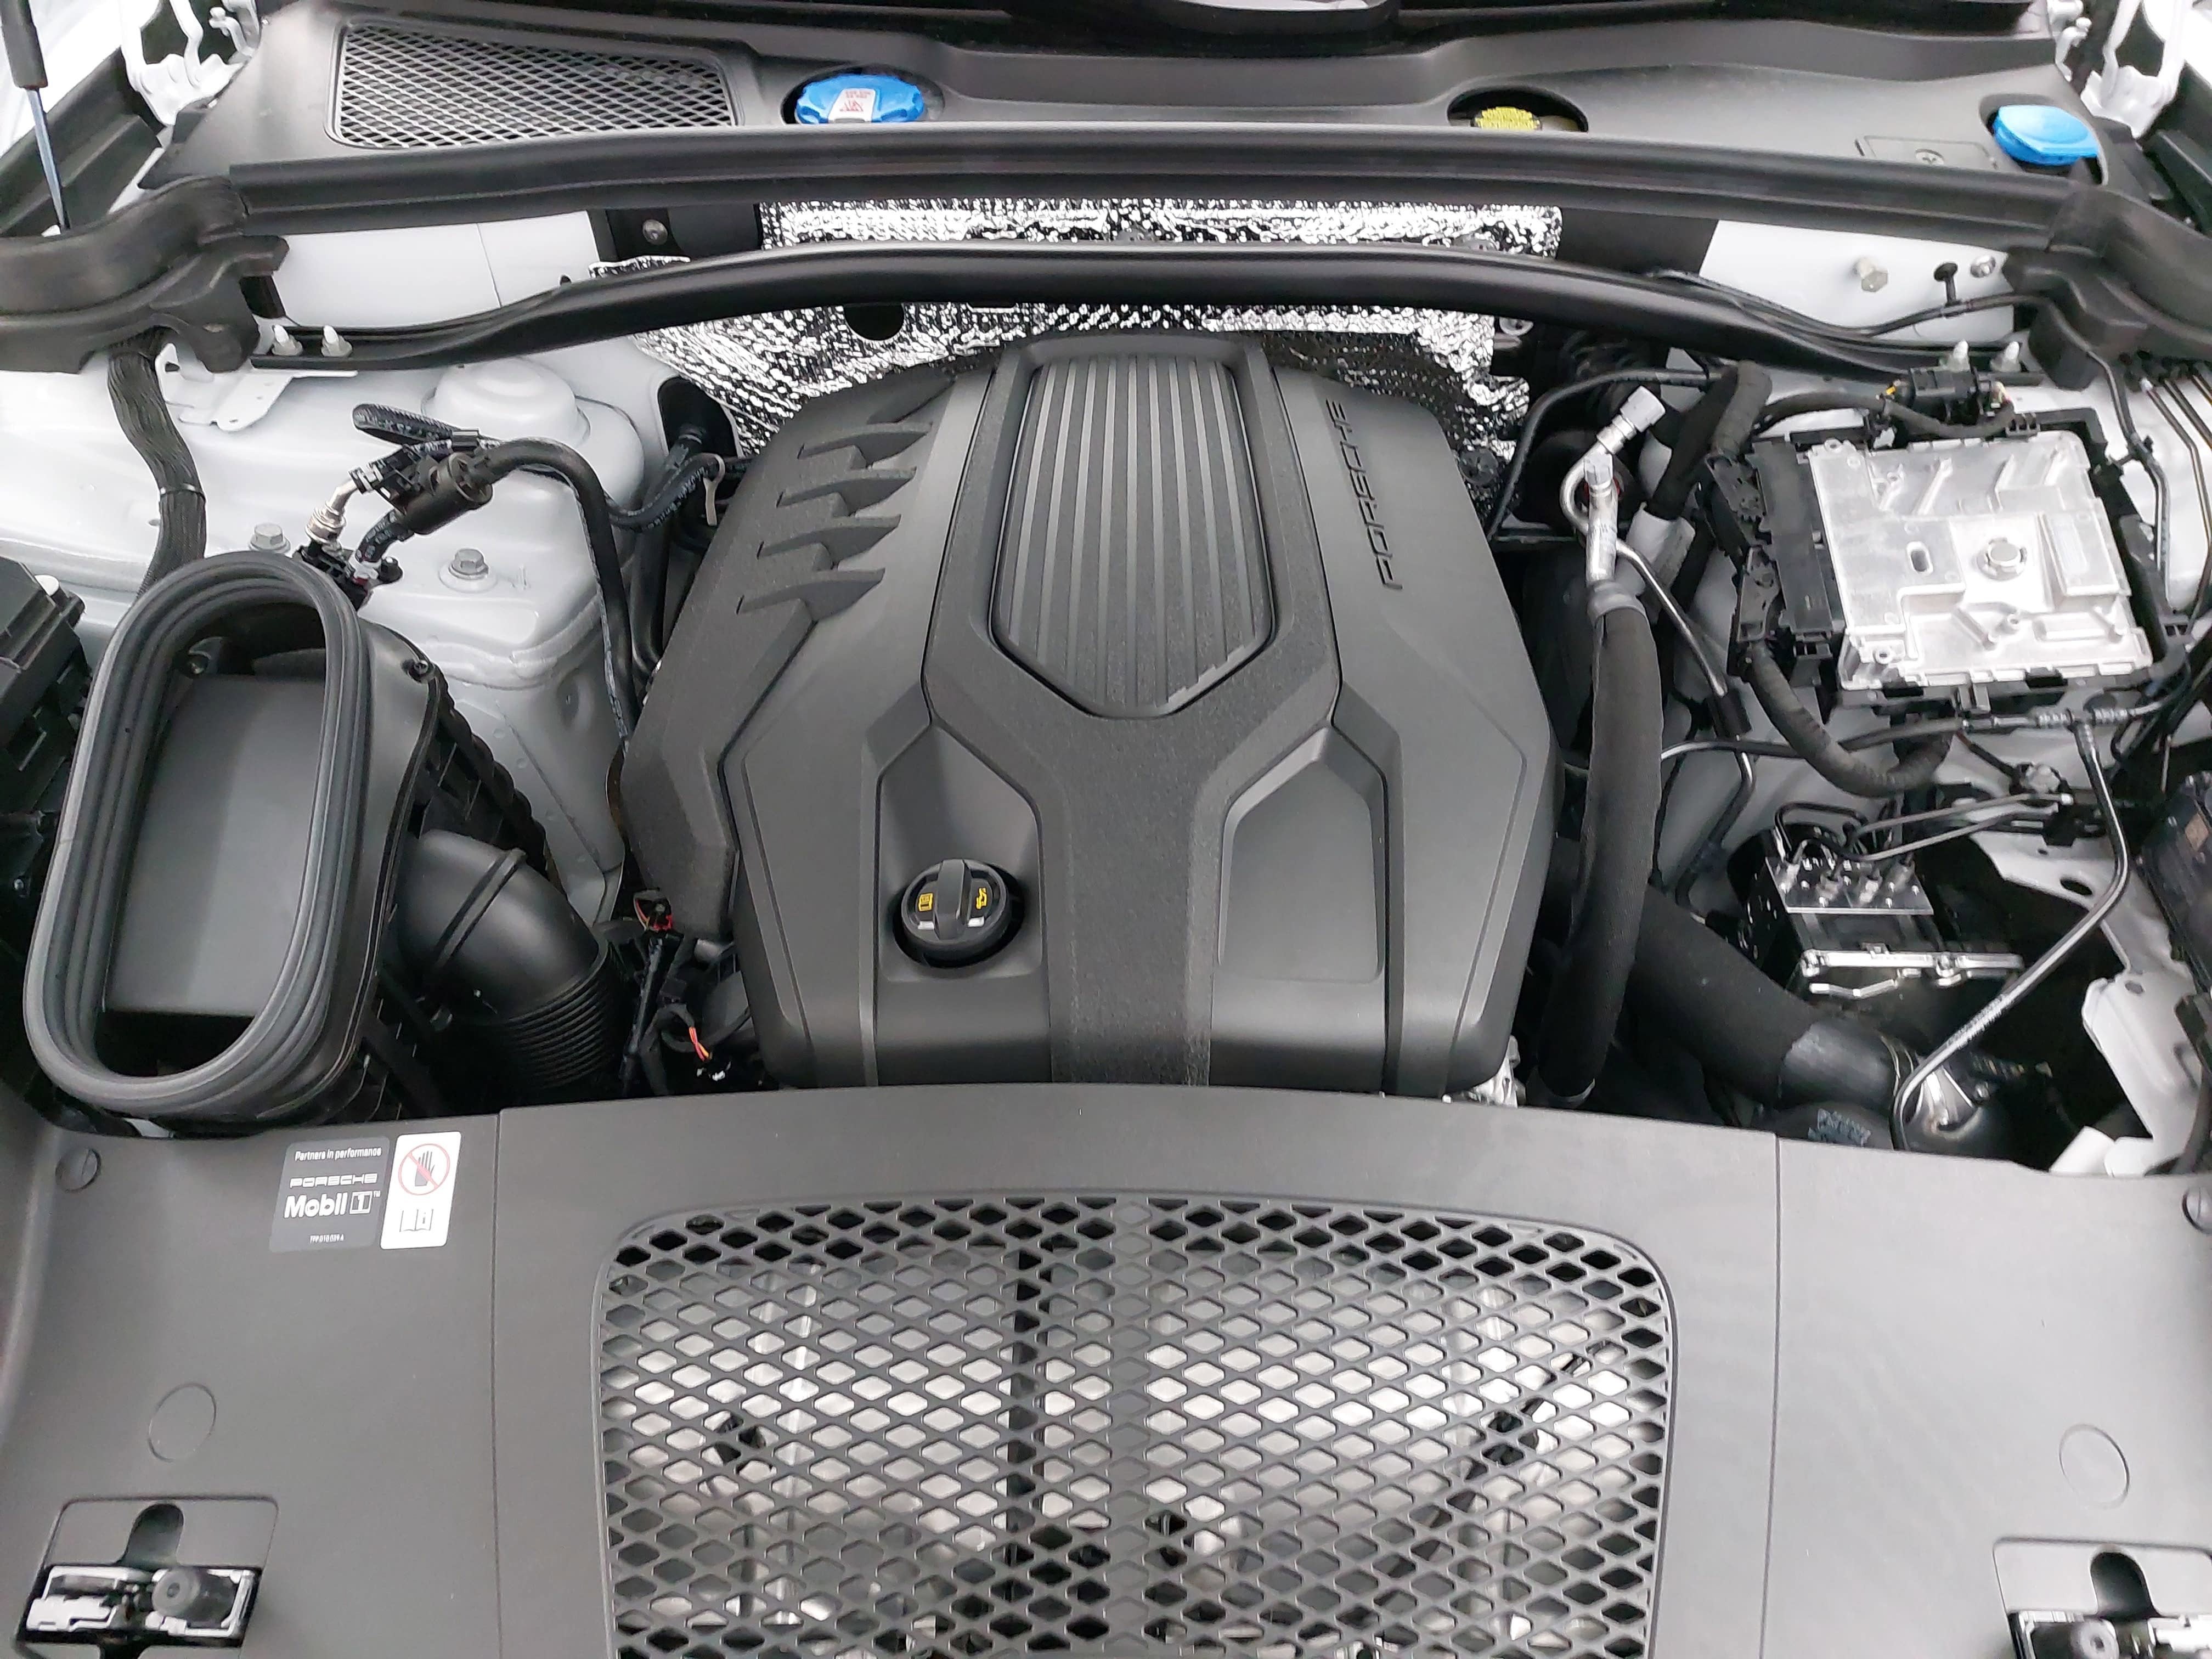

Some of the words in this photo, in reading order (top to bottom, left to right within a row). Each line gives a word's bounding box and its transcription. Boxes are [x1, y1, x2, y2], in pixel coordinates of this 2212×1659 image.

[1325, 398, 1403, 590] PORSCHE
[295, 1151, 326, 1161] Partners
[327, 1149, 334, 1159] in
[335, 1147, 382, 1161] performance
[290, 1173, 378, 1189] PORSCHE
[284, 1192, 348, 1218] Mobil
